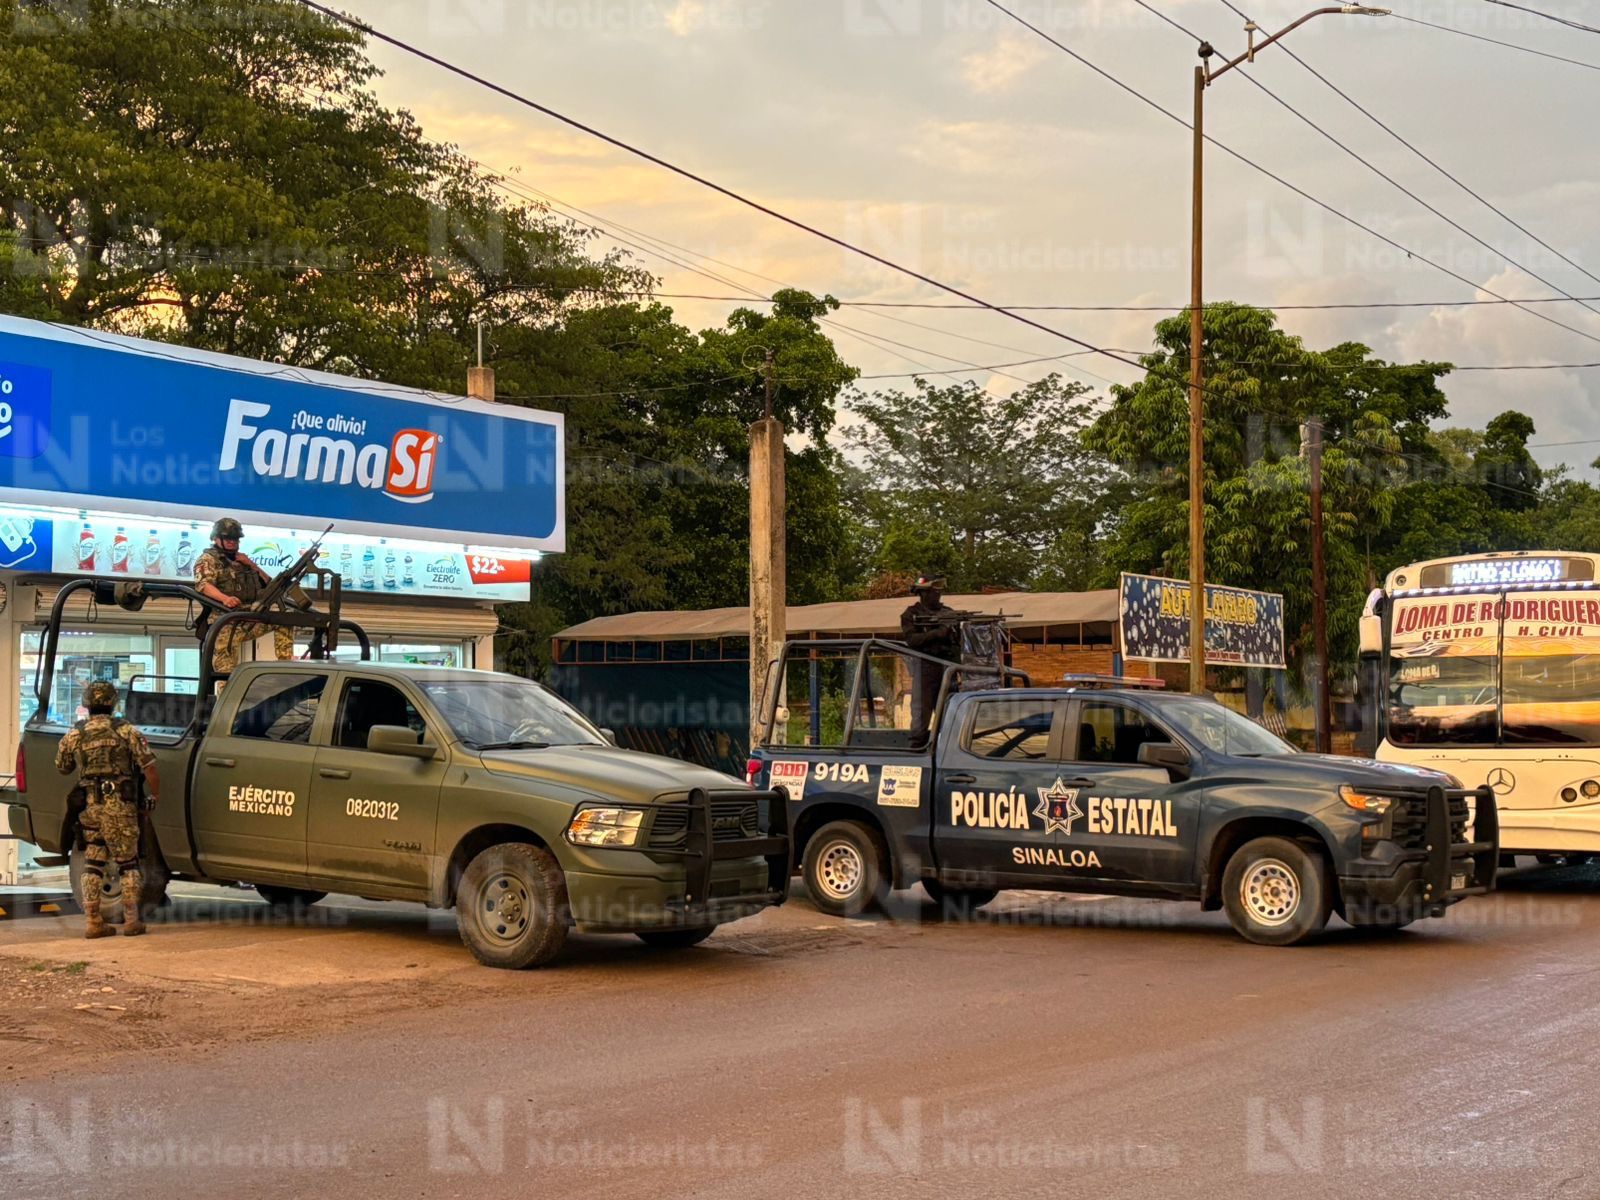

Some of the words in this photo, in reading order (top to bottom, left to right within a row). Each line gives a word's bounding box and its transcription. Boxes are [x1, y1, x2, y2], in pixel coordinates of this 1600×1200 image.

[291, 410, 322, 430] ¡Que
[327, 414, 366, 435] alivio!
[432, 574, 455, 584] ZERO
[1396, 604, 1447, 634] LOMA
[1452, 602, 1475, 624] DE
[1480, 600, 1600, 625] RODRIGUER
[1423, 627, 1483, 641] CENTRO
[1518, 626, 1533, 636] H.
[1539, 626, 1584, 637] CIVIL
[774, 764, 803, 775] 911
[814, 762, 869, 783] 919A
[229, 784, 295, 805] EJÉRCITO
[229, 801, 293, 816] MEXICANO
[346, 798, 399, 820] 0820312
[951, 785, 1030, 829] POLICÍA
[1088, 797, 1178, 837] ESTATAL
[1012, 847, 1102, 868] SINALOA
